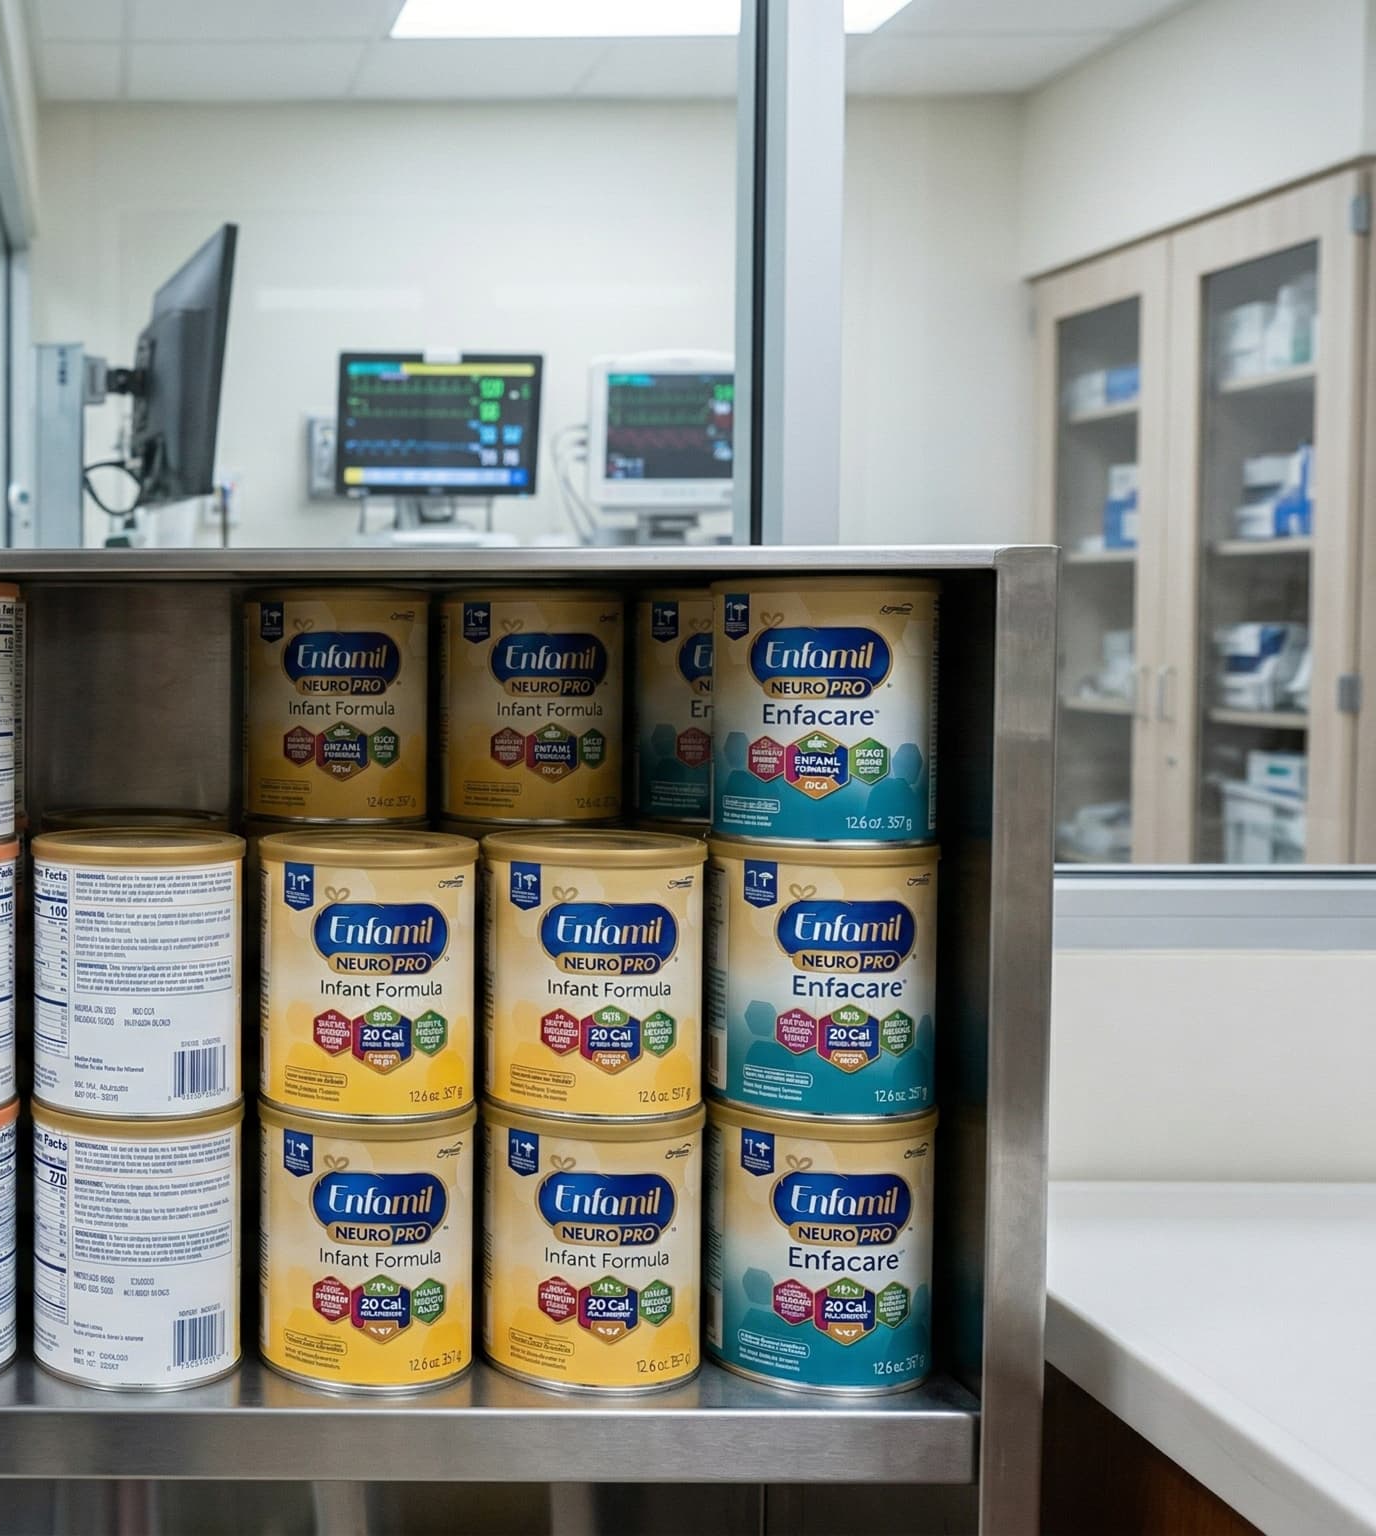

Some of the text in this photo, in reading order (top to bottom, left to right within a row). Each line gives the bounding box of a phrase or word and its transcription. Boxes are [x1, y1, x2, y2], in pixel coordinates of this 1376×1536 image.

[297, 644, 387, 669] Enfamil
[506, 645, 597, 670] Enfamil
[766, 641, 874, 670] Enfamil
[302, 680, 381, 692] NEURO PRO
[512, 681, 591, 693] NEURO PRO
[771, 681, 865, 694] NEURO PRO
[289, 701, 395, 716] Infant Formula
[497, 702, 603, 717] Infant Formula
[763, 704, 875, 726] Enfacare
[330, 916, 433, 945] Enfamil
[557, 915, 662, 945] Enfamil
[795, 913, 902, 942] Enfamil
[336, 957, 427, 971] NEURO PRO
[564, 957, 656, 971] NEURO PRO
[802, 955, 895, 969] NEURO PRO
[321, 980, 442, 997] Infant Formula
[548, 979, 671, 998] Infant Formula
[793, 975, 902, 998] Enfacare
[363, 1028, 403, 1041] 20 Cal
[591, 1028, 631, 1041] 20 Cal
[829, 1028, 869, 1040] 20 Cal
[329, 1184, 432, 1216] Enfamil
[555, 1184, 661, 1216] Enfamil
[791, 1185, 899, 1216] Enfamil
[335, 1226, 427, 1241] NEURO PRO
[562, 1226, 655, 1242] NEURO PRO
[798, 1226, 892, 1242] NEURO PRO
[319, 1248, 441, 1268] Infant Formula
[545, 1248, 669, 1269] Infant Formula
[789, 1247, 899, 1272] Enfacare
[361, 1298, 379, 1310] 20
[588, 1298, 605, 1311] 20
[825, 1300, 843, 1313] 20
